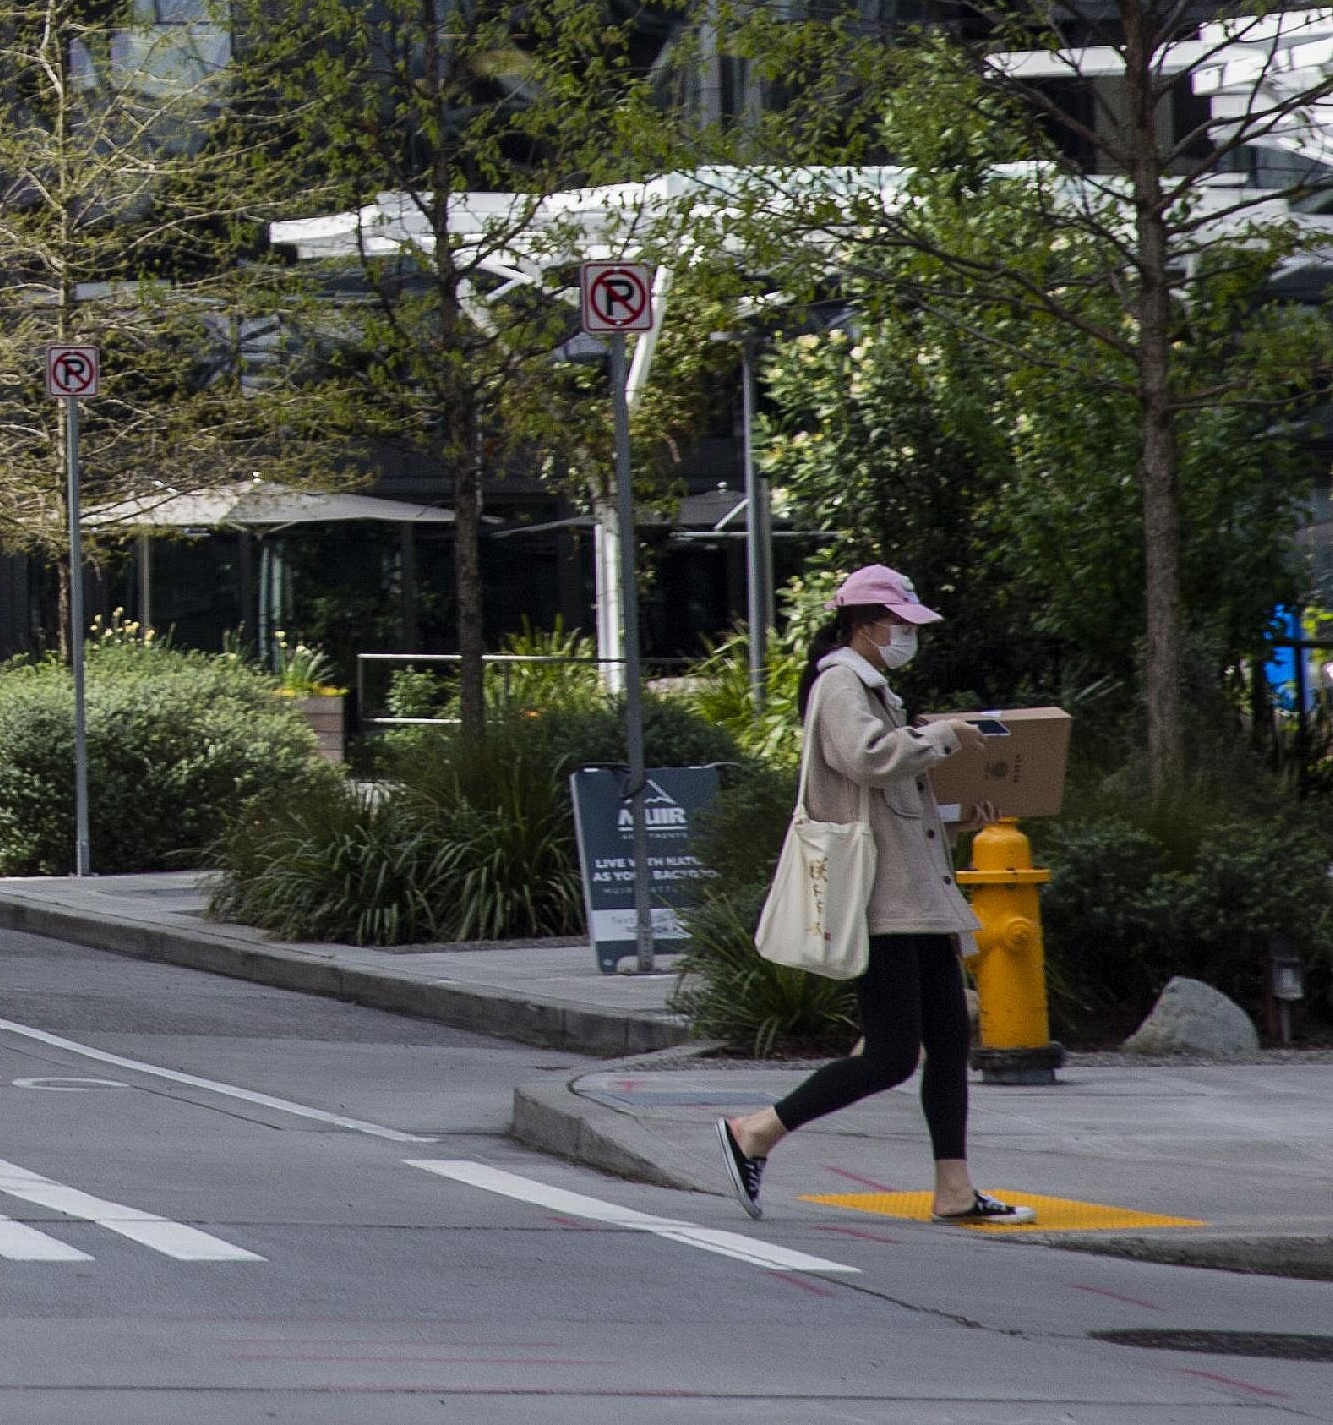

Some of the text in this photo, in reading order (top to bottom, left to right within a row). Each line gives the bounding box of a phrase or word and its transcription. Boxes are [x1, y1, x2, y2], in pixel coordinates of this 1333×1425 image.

[595, 858, 626, 868] LIVE
[628, 856, 663, 867] WTH
[592, 871, 611, 882] AS
